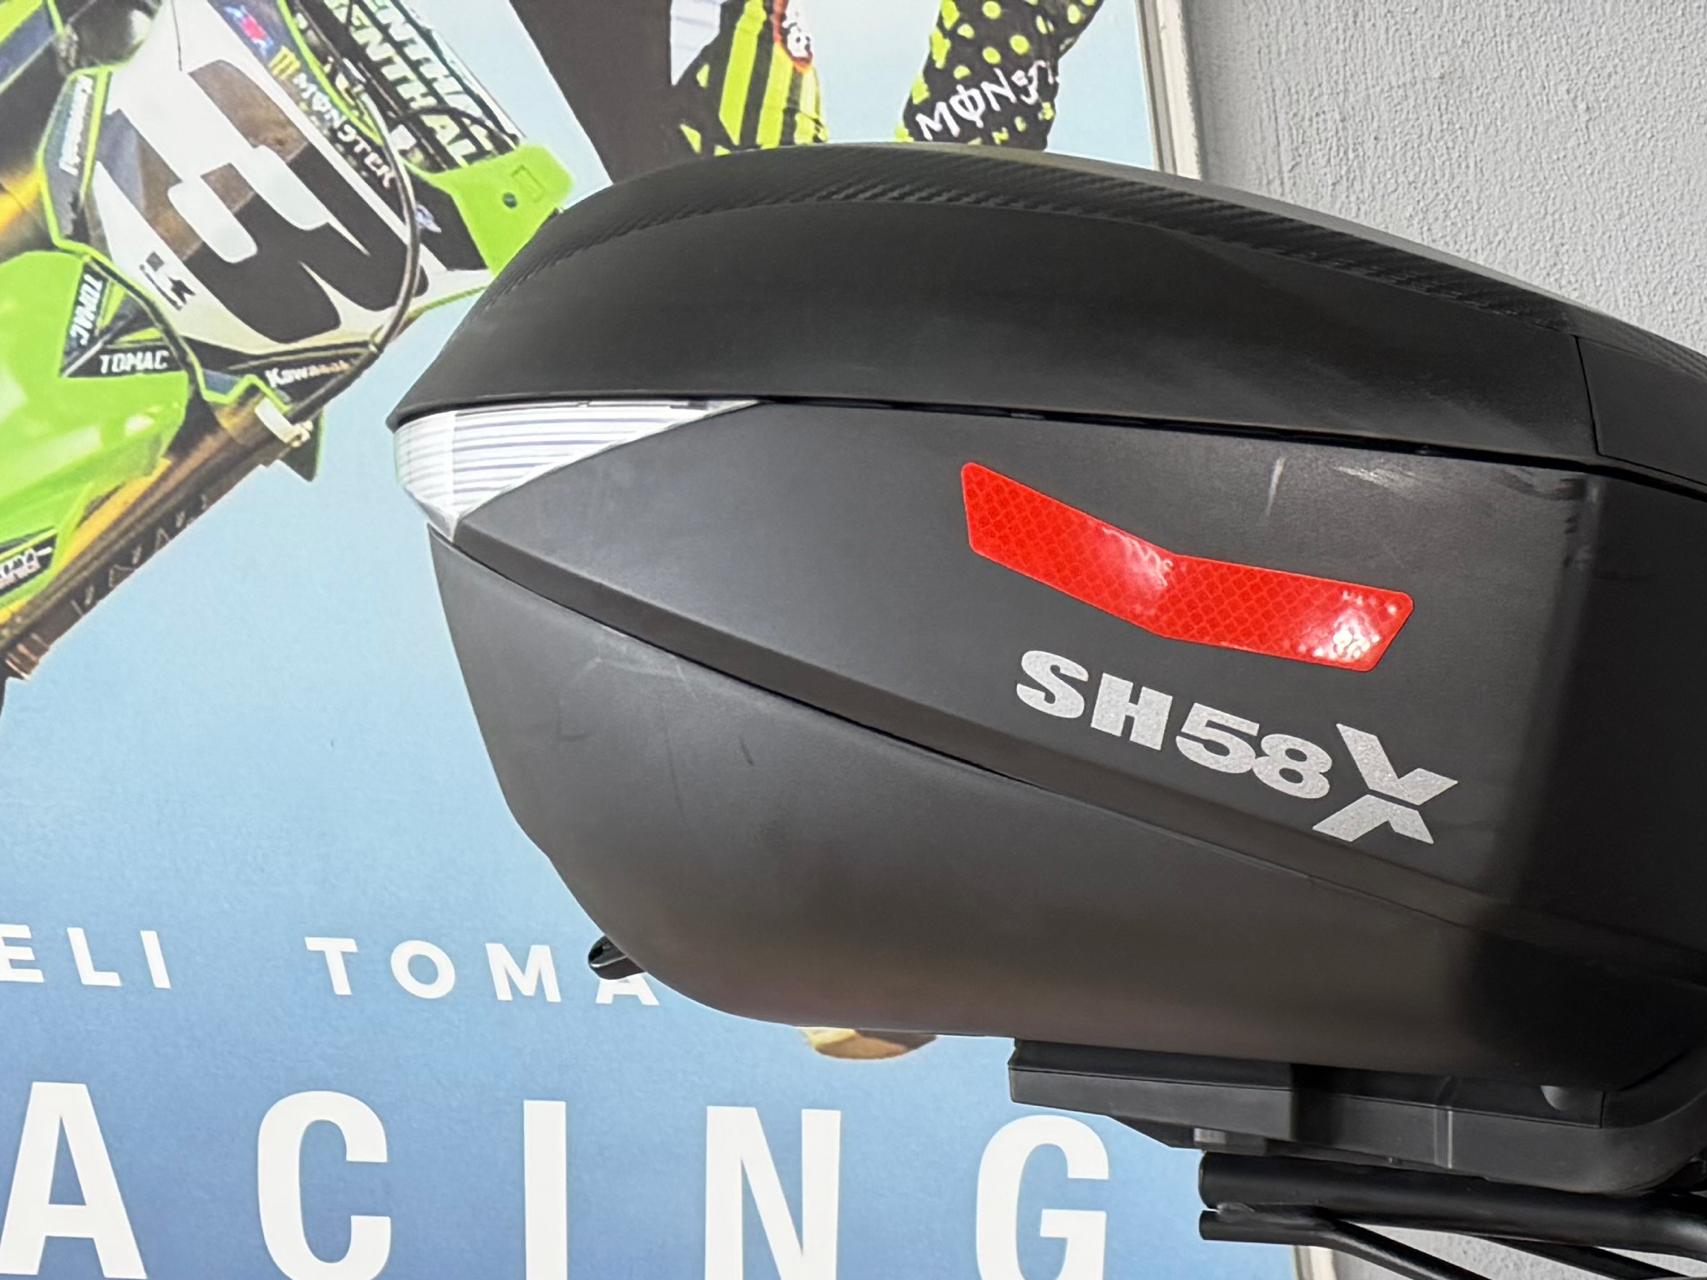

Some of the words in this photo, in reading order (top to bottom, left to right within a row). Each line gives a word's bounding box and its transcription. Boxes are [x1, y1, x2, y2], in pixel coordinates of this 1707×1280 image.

[99, 350, 170, 374] TOMAC
[1016, 650, 1458, 843] SH58X
[0, 924, 171, 989] ELI
